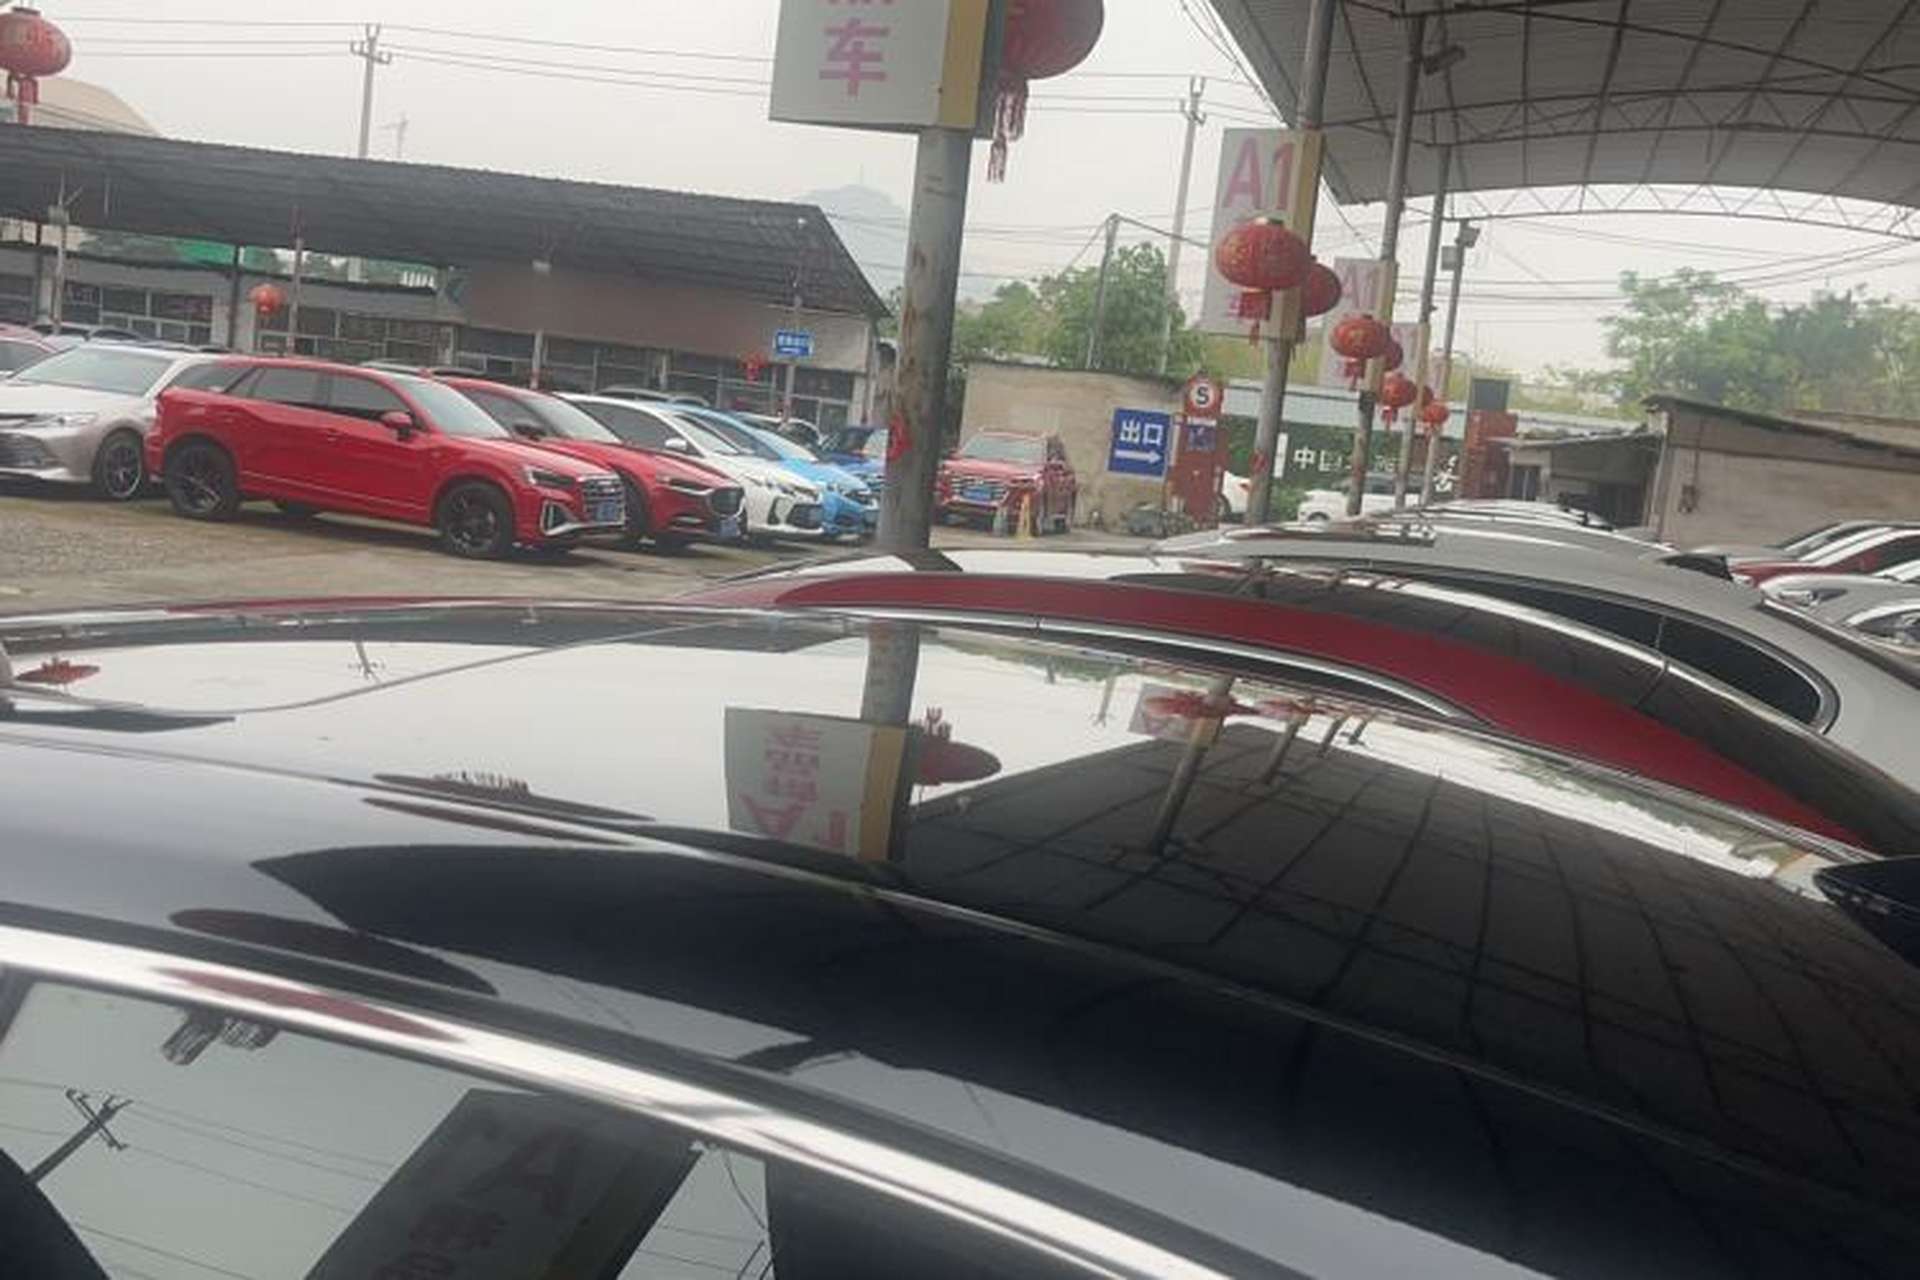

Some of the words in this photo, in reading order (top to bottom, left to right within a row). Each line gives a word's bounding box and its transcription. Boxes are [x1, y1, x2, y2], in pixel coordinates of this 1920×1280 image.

[818, 0, 893, 97] 车
[1223, 136, 1295, 209] A1
[1119, 419, 1164, 447] 出口
